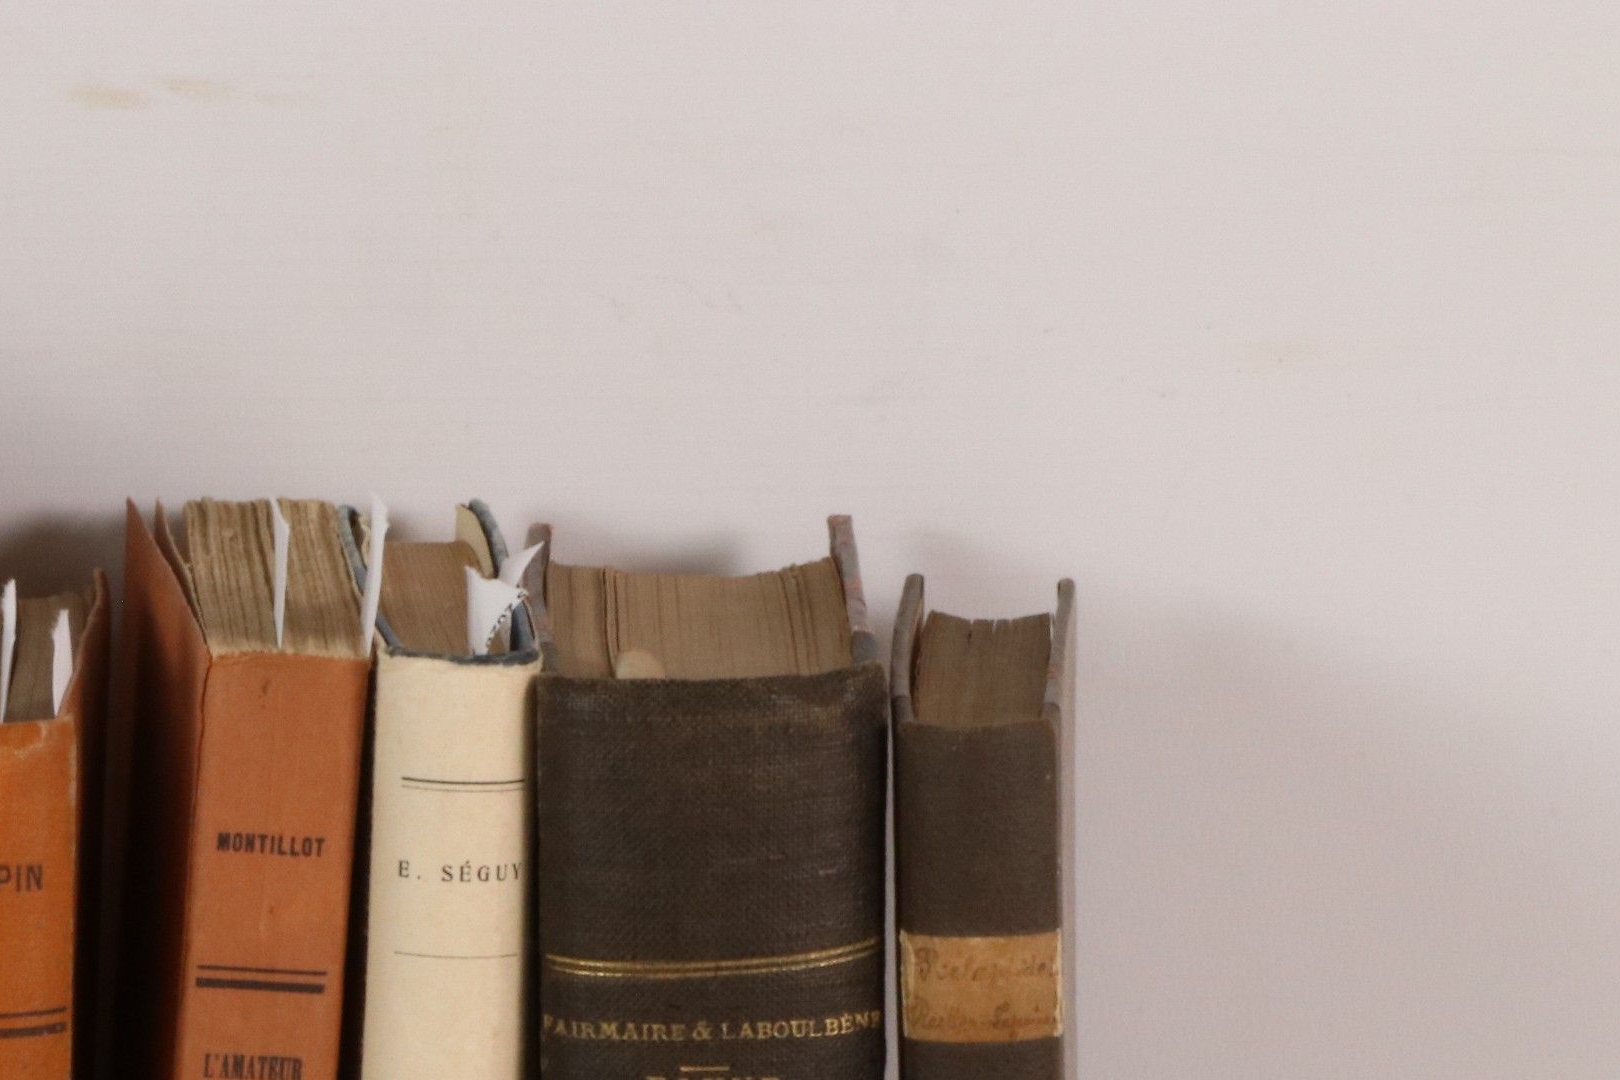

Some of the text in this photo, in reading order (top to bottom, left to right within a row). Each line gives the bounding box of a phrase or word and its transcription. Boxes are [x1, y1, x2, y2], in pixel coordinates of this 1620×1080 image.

[217, 831, 325, 857] MONTILLOT
[398, 859, 523, 883] E. SÉGUY
[692, 1020, 713, 1041] &
